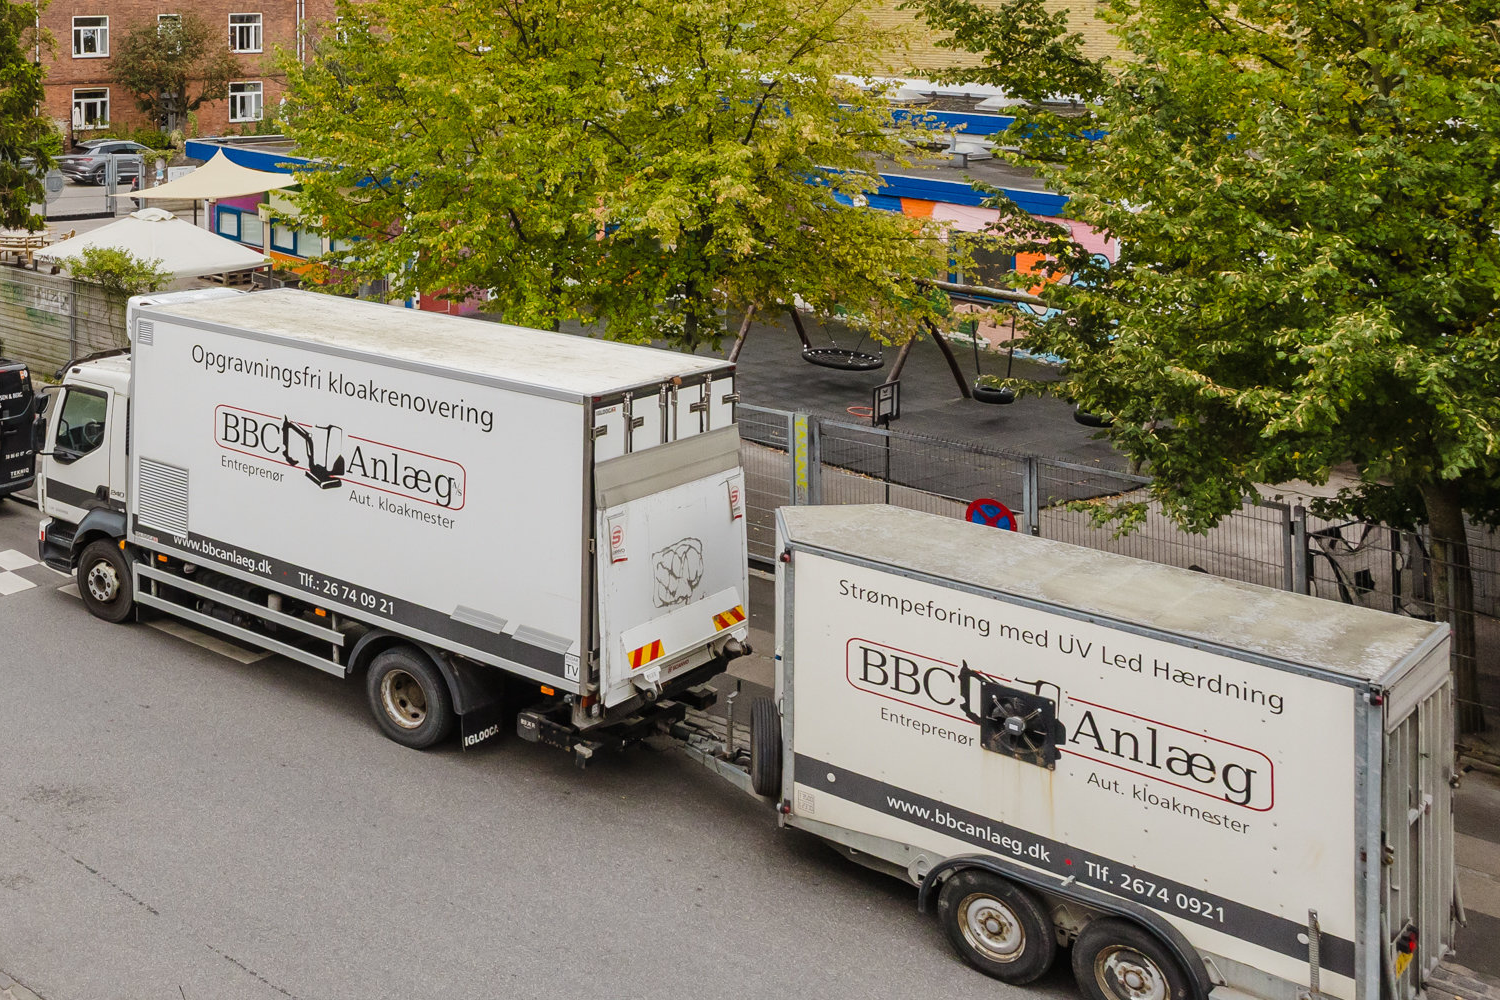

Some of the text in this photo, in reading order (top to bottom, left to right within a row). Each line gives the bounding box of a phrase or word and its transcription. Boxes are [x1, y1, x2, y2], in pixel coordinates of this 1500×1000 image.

[191, 344, 494, 433] Opgravningsfri kloakrenovering
[221, 412, 281, 454] BBC
[346, 445, 455, 507] Anlæg
[221, 455, 285, 483] Entreprenør
[349, 489, 456, 530] Aut. kloakmester
[173, 535, 394, 616] www.bbcanlaeg.dk Tlf.: 26 74 09 21
[566, 664, 579, 676] TV
[838, 579, 1284, 715] Strømpeforing med UV Led Hærdning
[859, 645, 1258, 806] BBC Anlæg
[880, 707, 975, 747] Entreprenør
[1087, 772, 1250, 834] Aut. kloakmester
[886, 795, 1225, 923] www.bbcanlaeg.dk Tlf. 2674 0921
